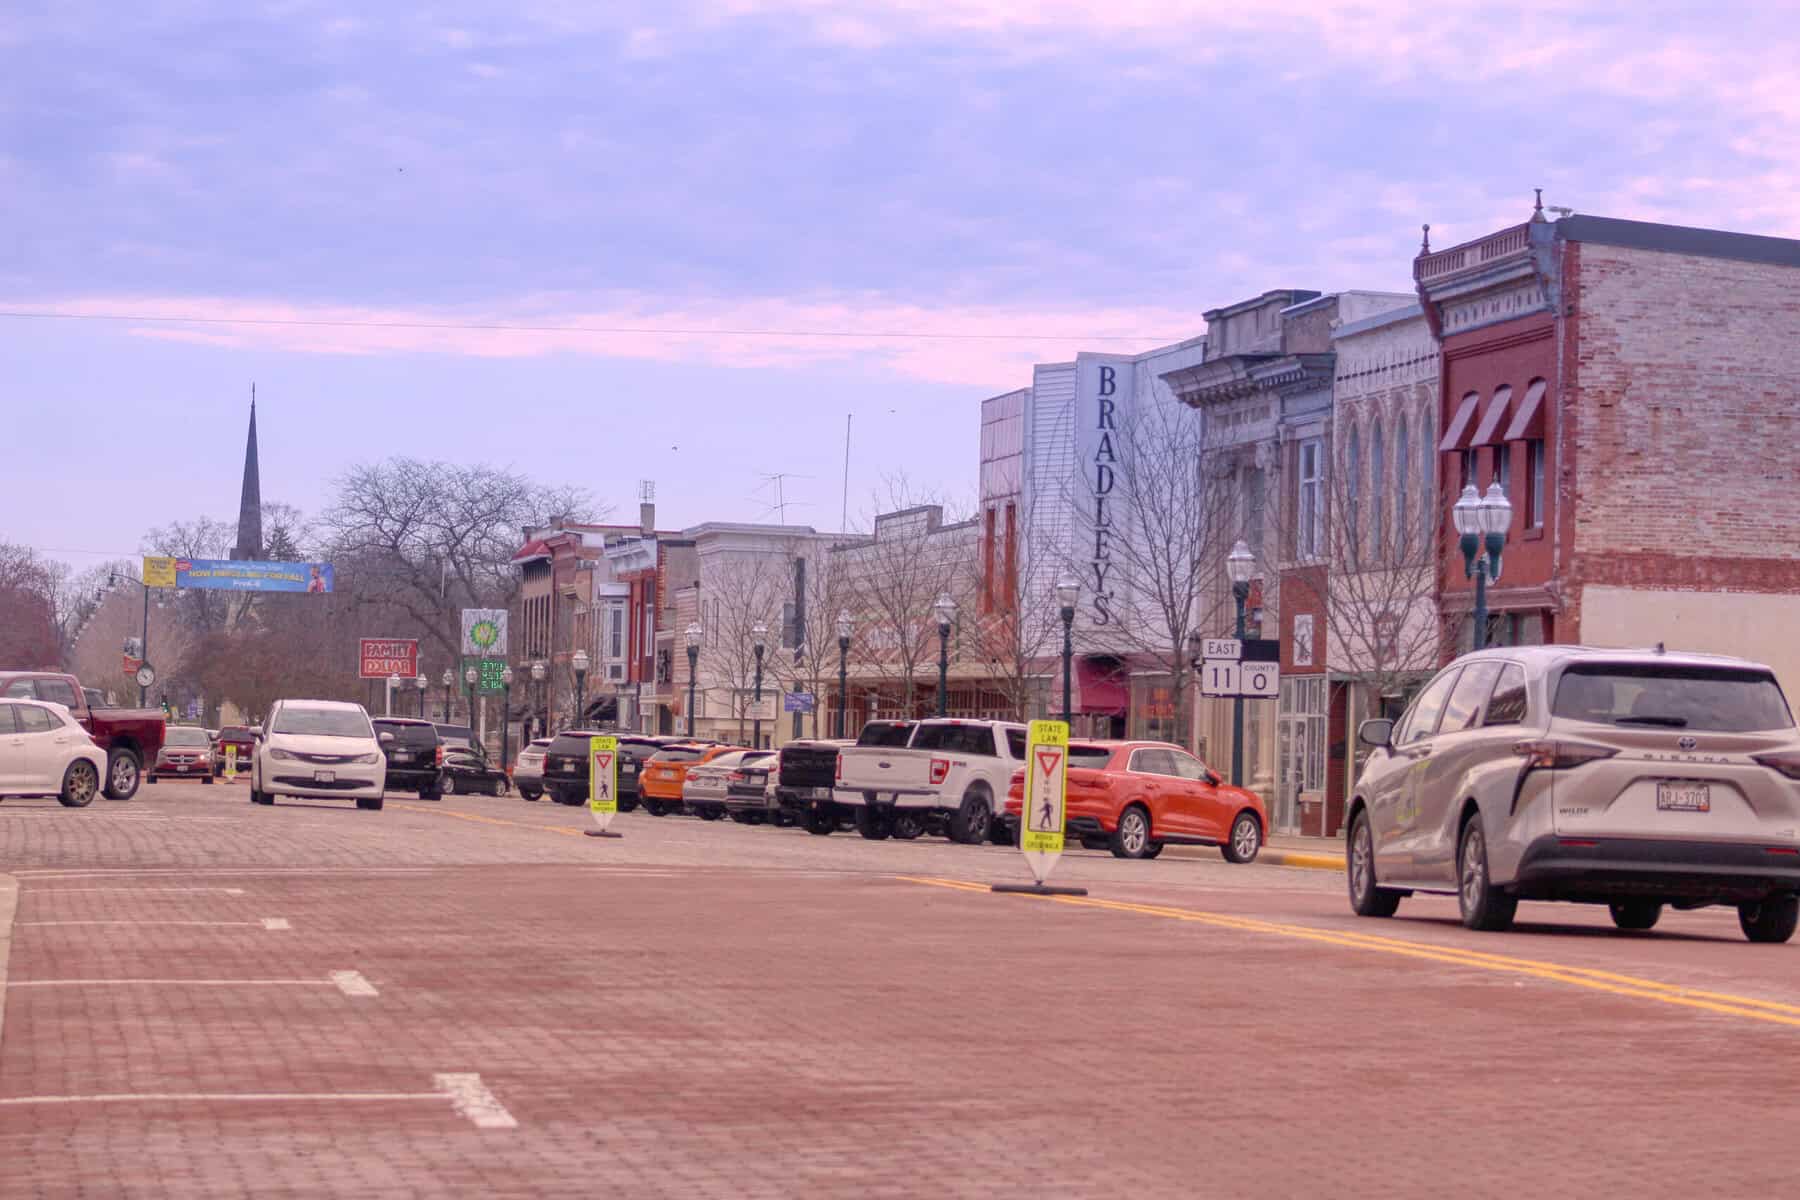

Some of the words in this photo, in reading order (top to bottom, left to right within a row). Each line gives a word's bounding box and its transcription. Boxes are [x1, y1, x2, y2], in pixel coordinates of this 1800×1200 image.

[1092, 366, 1117, 626] BRADLEY'S
[365, 643, 411, 657] FAMILY
[1208, 641, 1236, 655] EAST
[365, 659, 410, 673] DOLLAR
[1244, 664, 1276, 672] COUNTY
[1212, 667, 1230, 688] 11
[1038, 723, 1062, 733] STATE
[1041, 734, 1058, 743] LAW
